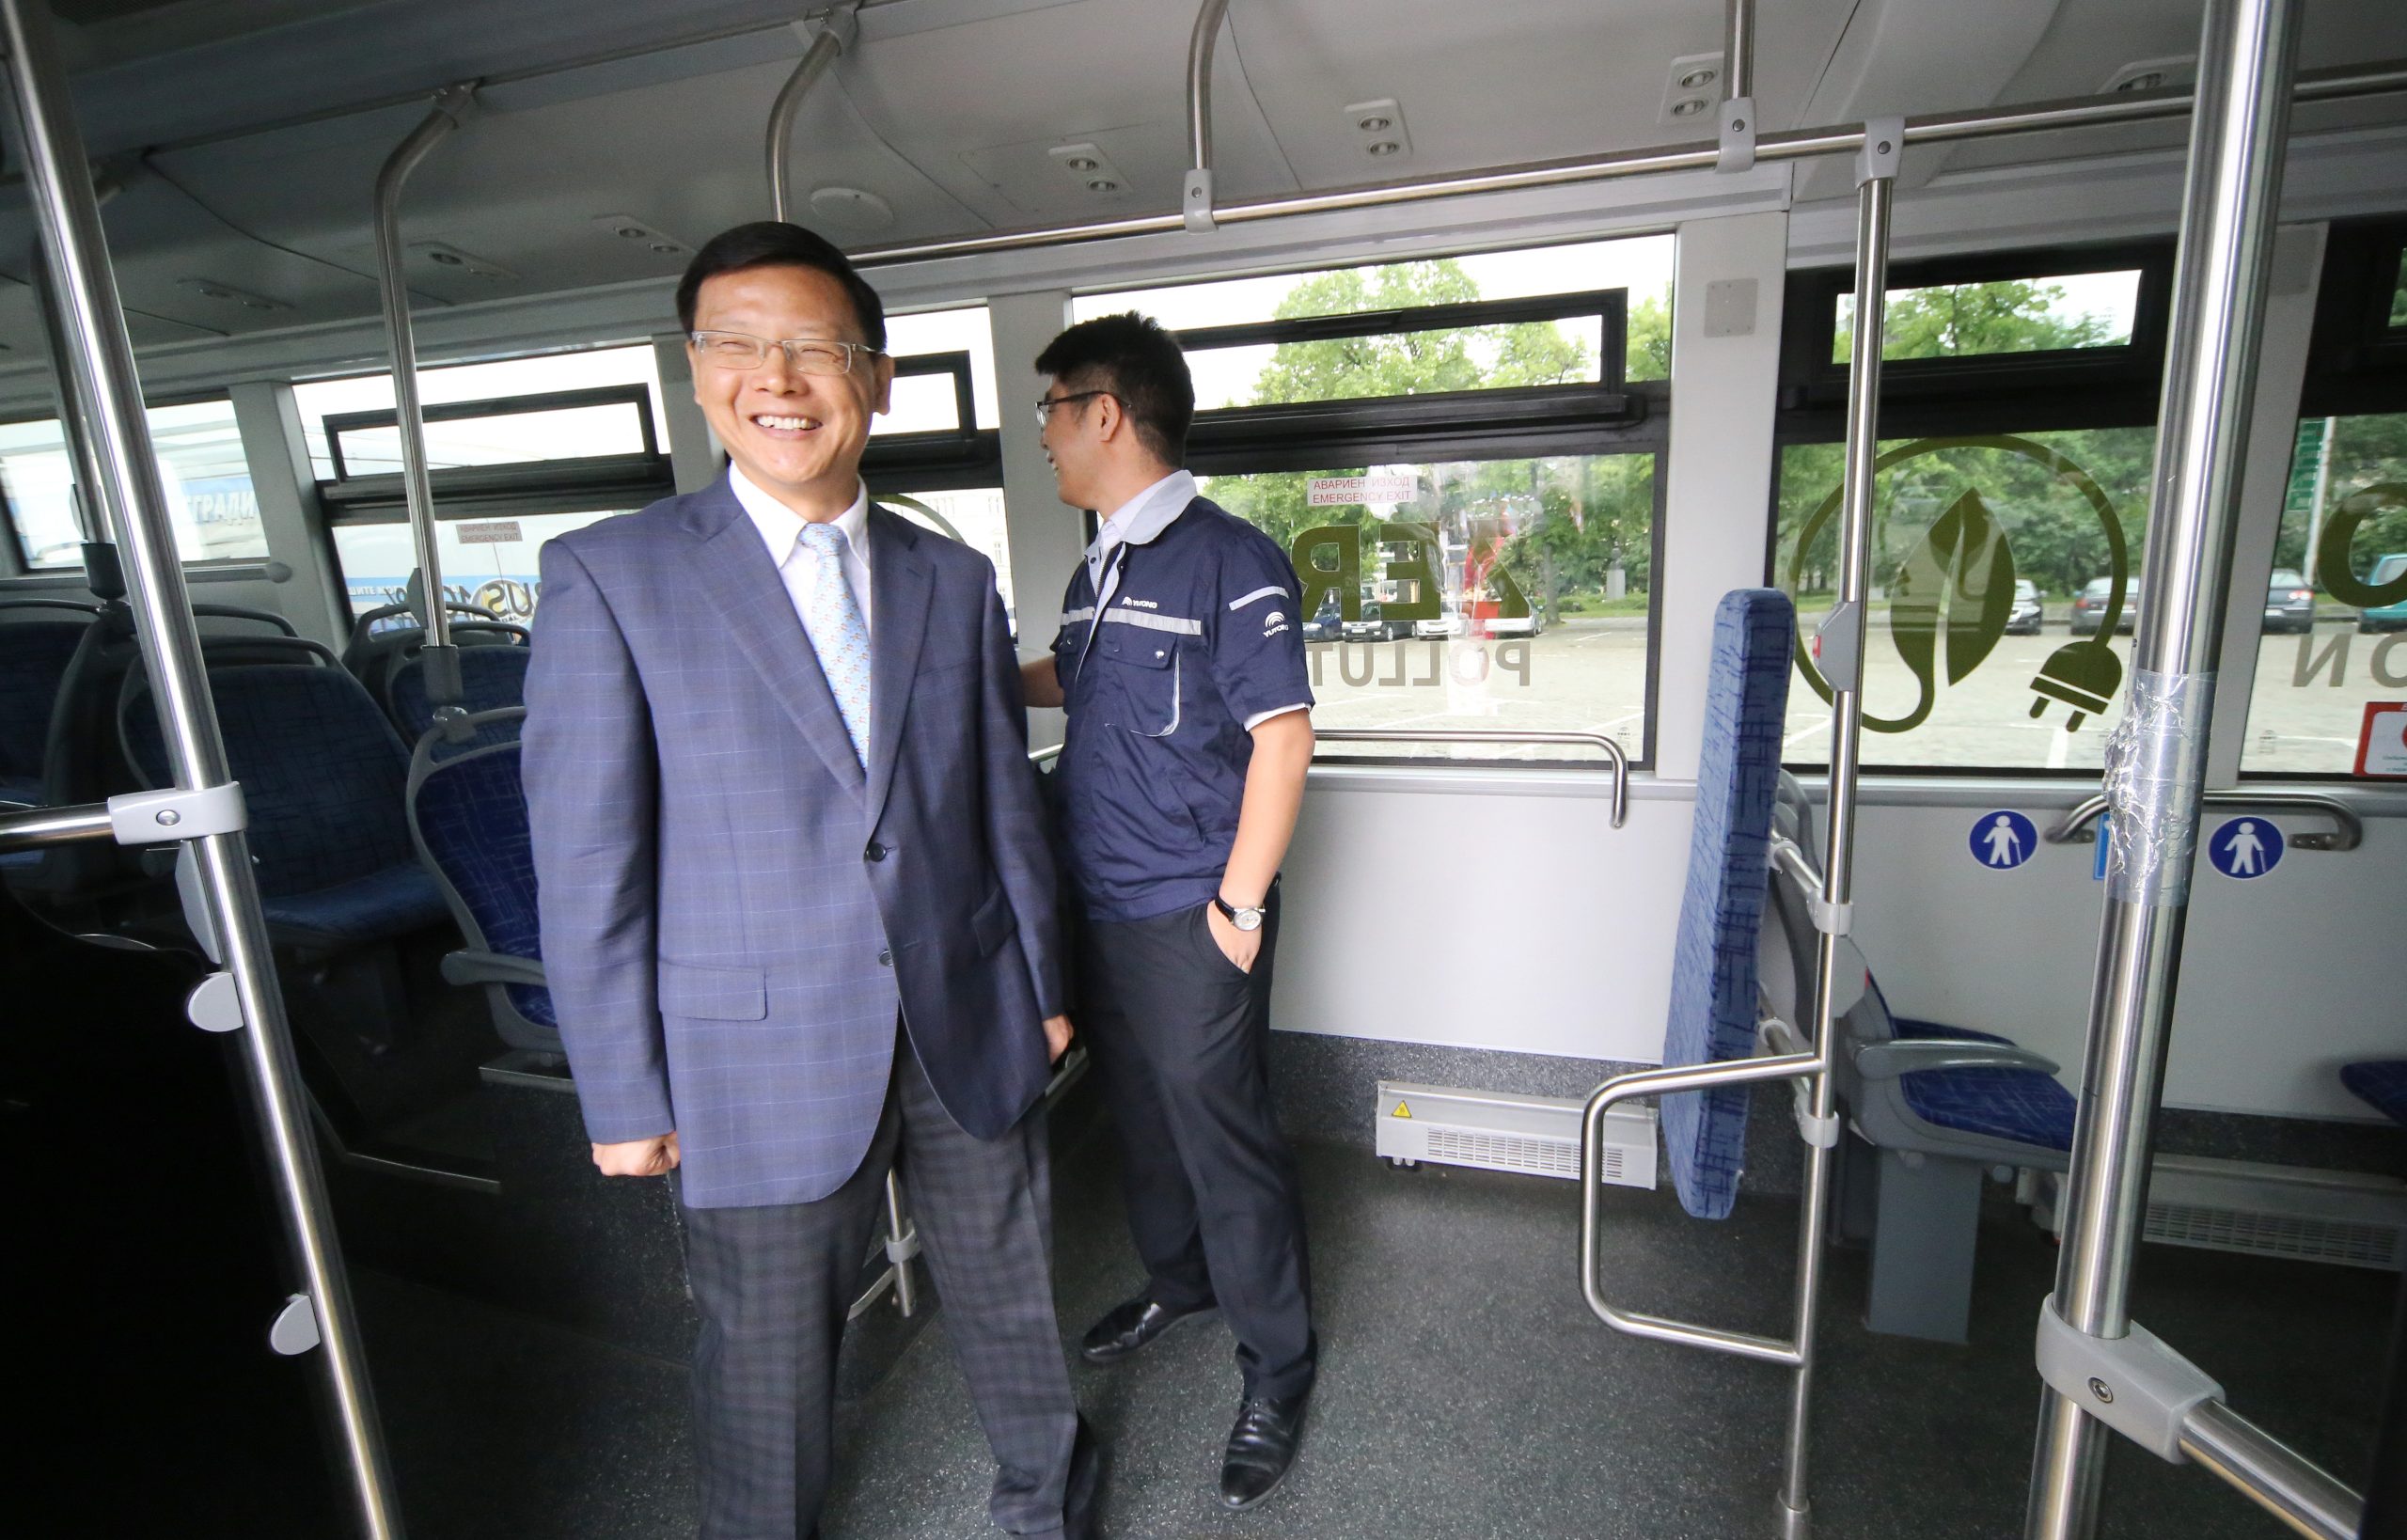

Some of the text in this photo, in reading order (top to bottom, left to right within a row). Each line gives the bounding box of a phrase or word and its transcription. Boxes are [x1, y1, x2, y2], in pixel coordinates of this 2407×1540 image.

[1314, 477, 1410, 490] АВАРИЕН ИЗХОД
[1313, 490, 1411, 503] EMERGENCY EXIT
